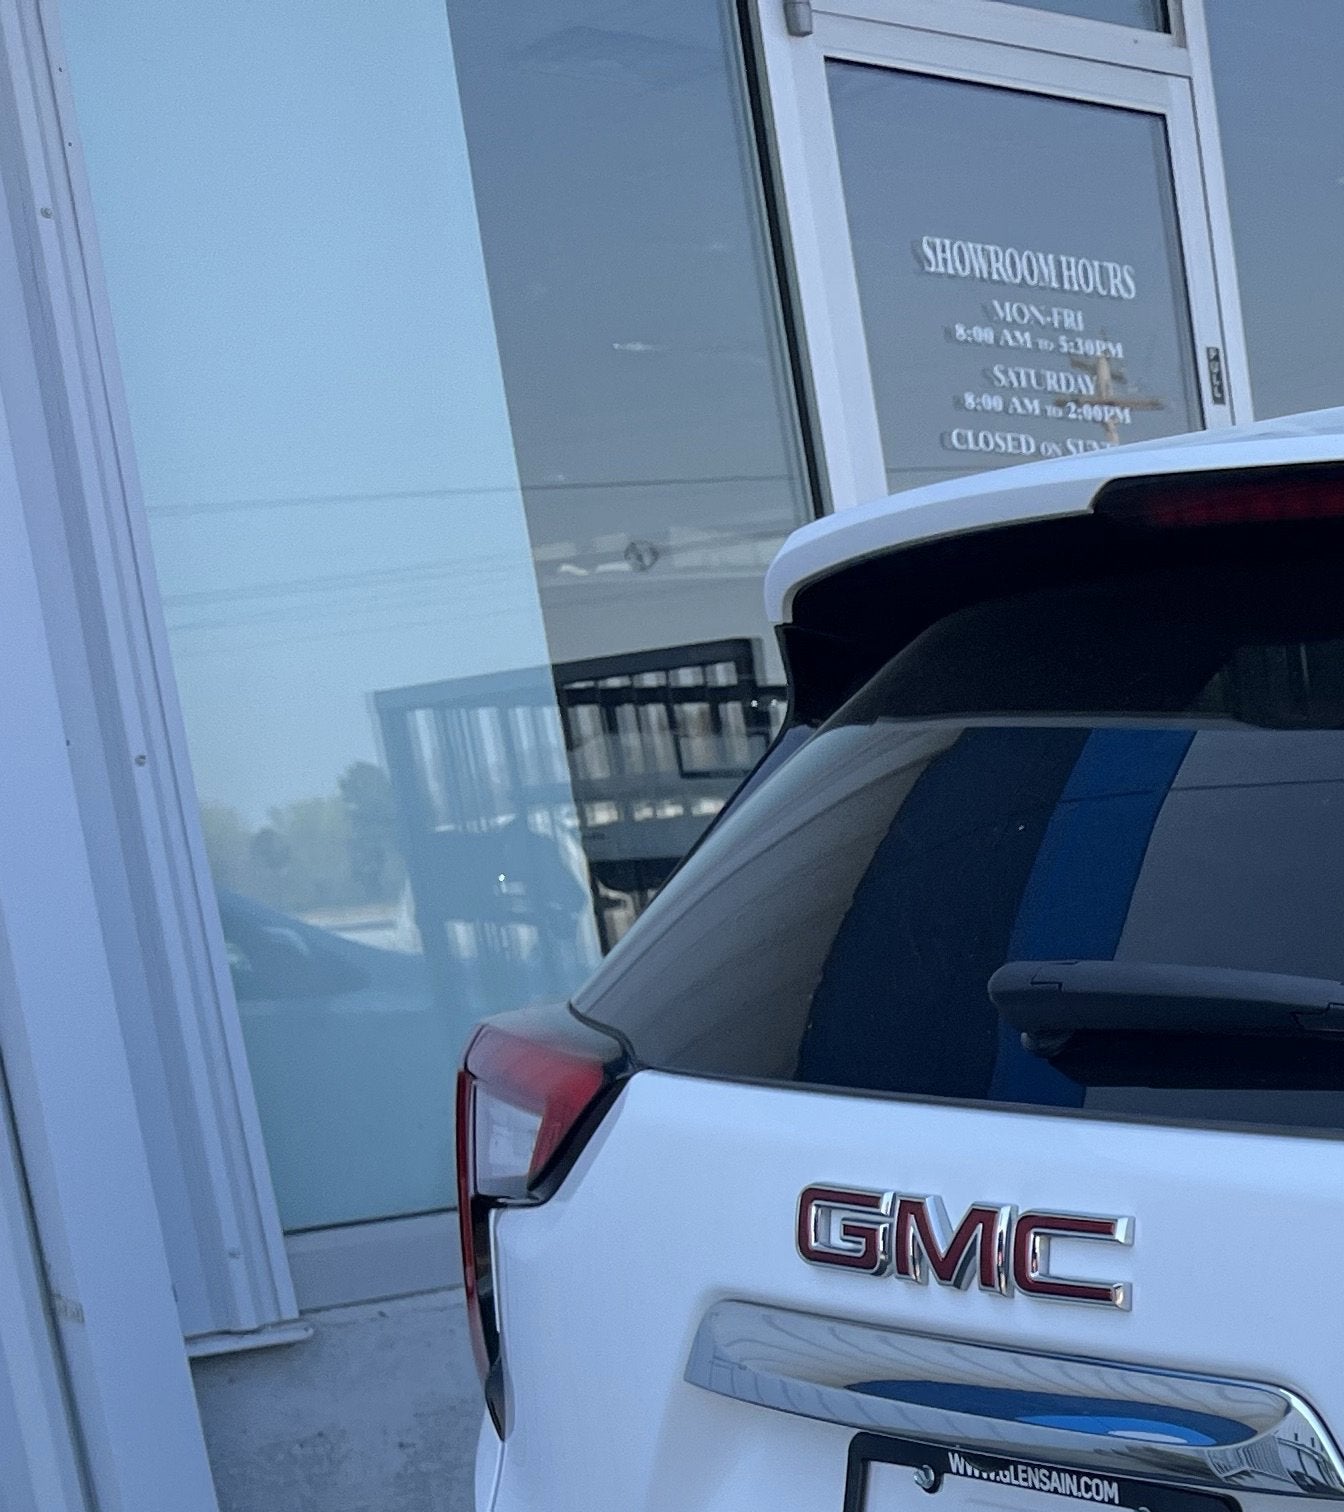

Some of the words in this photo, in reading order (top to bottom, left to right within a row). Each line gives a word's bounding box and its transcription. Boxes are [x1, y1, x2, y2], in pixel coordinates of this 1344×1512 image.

[922, 235, 1060, 289] SHOWROOM
[1060, 253, 1136, 300] HOURS
[991, 300, 1085, 332] MON-FRI
[954, 322, 995, 345] 8:00
[1000, 328, 1033, 349] AM
[991, 363, 1098, 396] SATURDAY
[963, 391, 1004, 413] 8:00
[1008, 396, 1042, 417] AM
[951, 427, 1036, 456] CLOSED
[795, 1181, 1136, 1313] GMC
